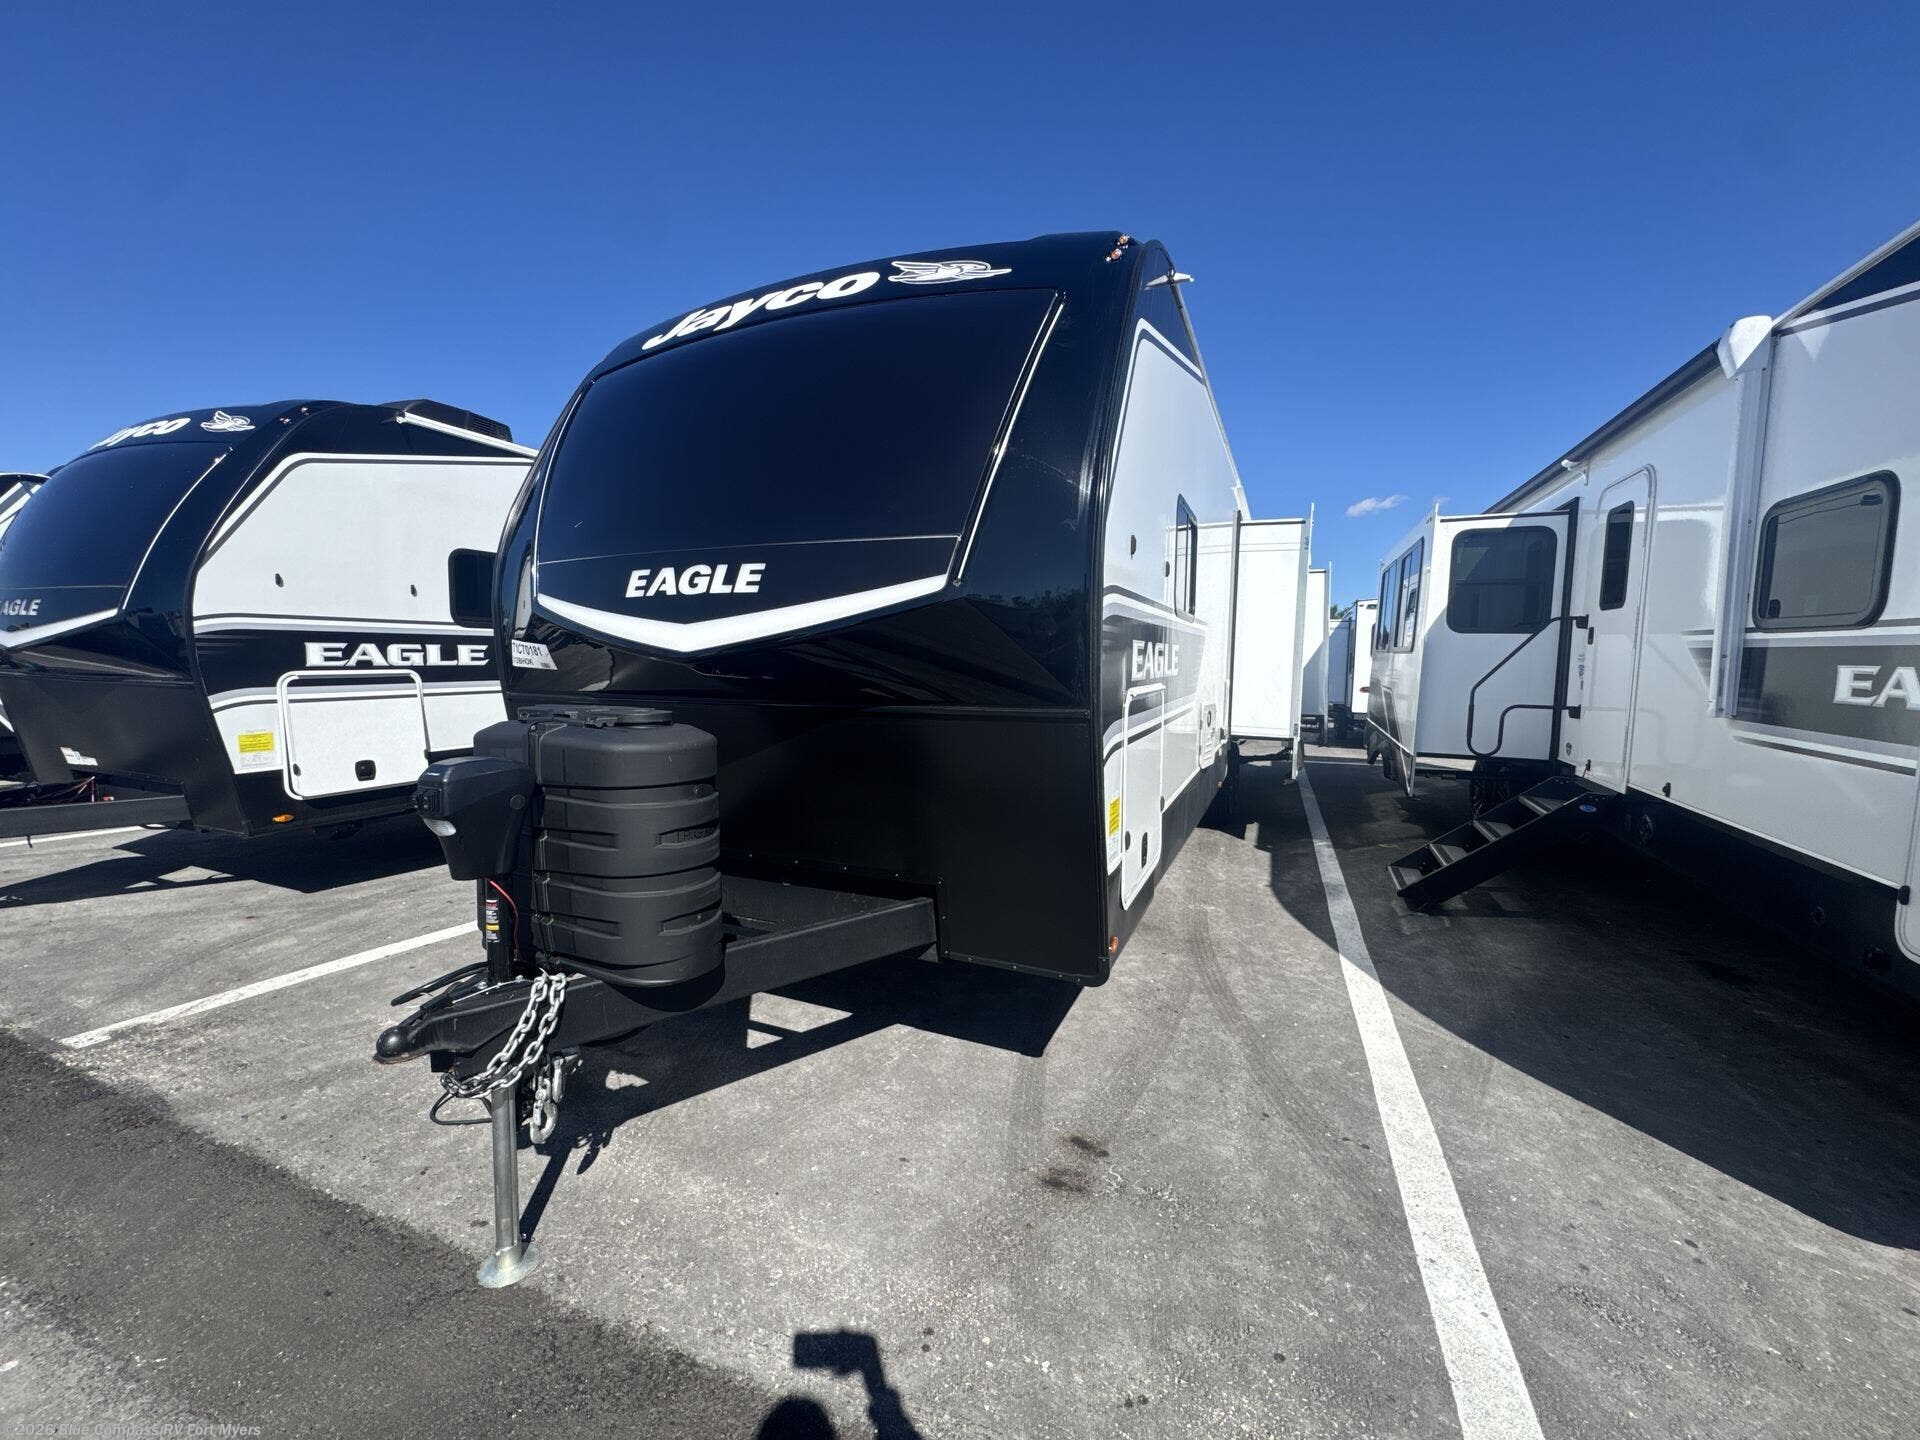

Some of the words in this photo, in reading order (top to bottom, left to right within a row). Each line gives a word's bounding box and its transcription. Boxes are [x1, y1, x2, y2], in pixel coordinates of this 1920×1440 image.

[642, 272, 880, 350] Jayco
[626, 562, 766, 598] EAGLE
[0, 598, 42, 616] AGLE
[304, 641, 490, 668] EAGLE
[1130, 639, 1180, 682] EAGLE
[1833, 664, 1920, 712] EA
